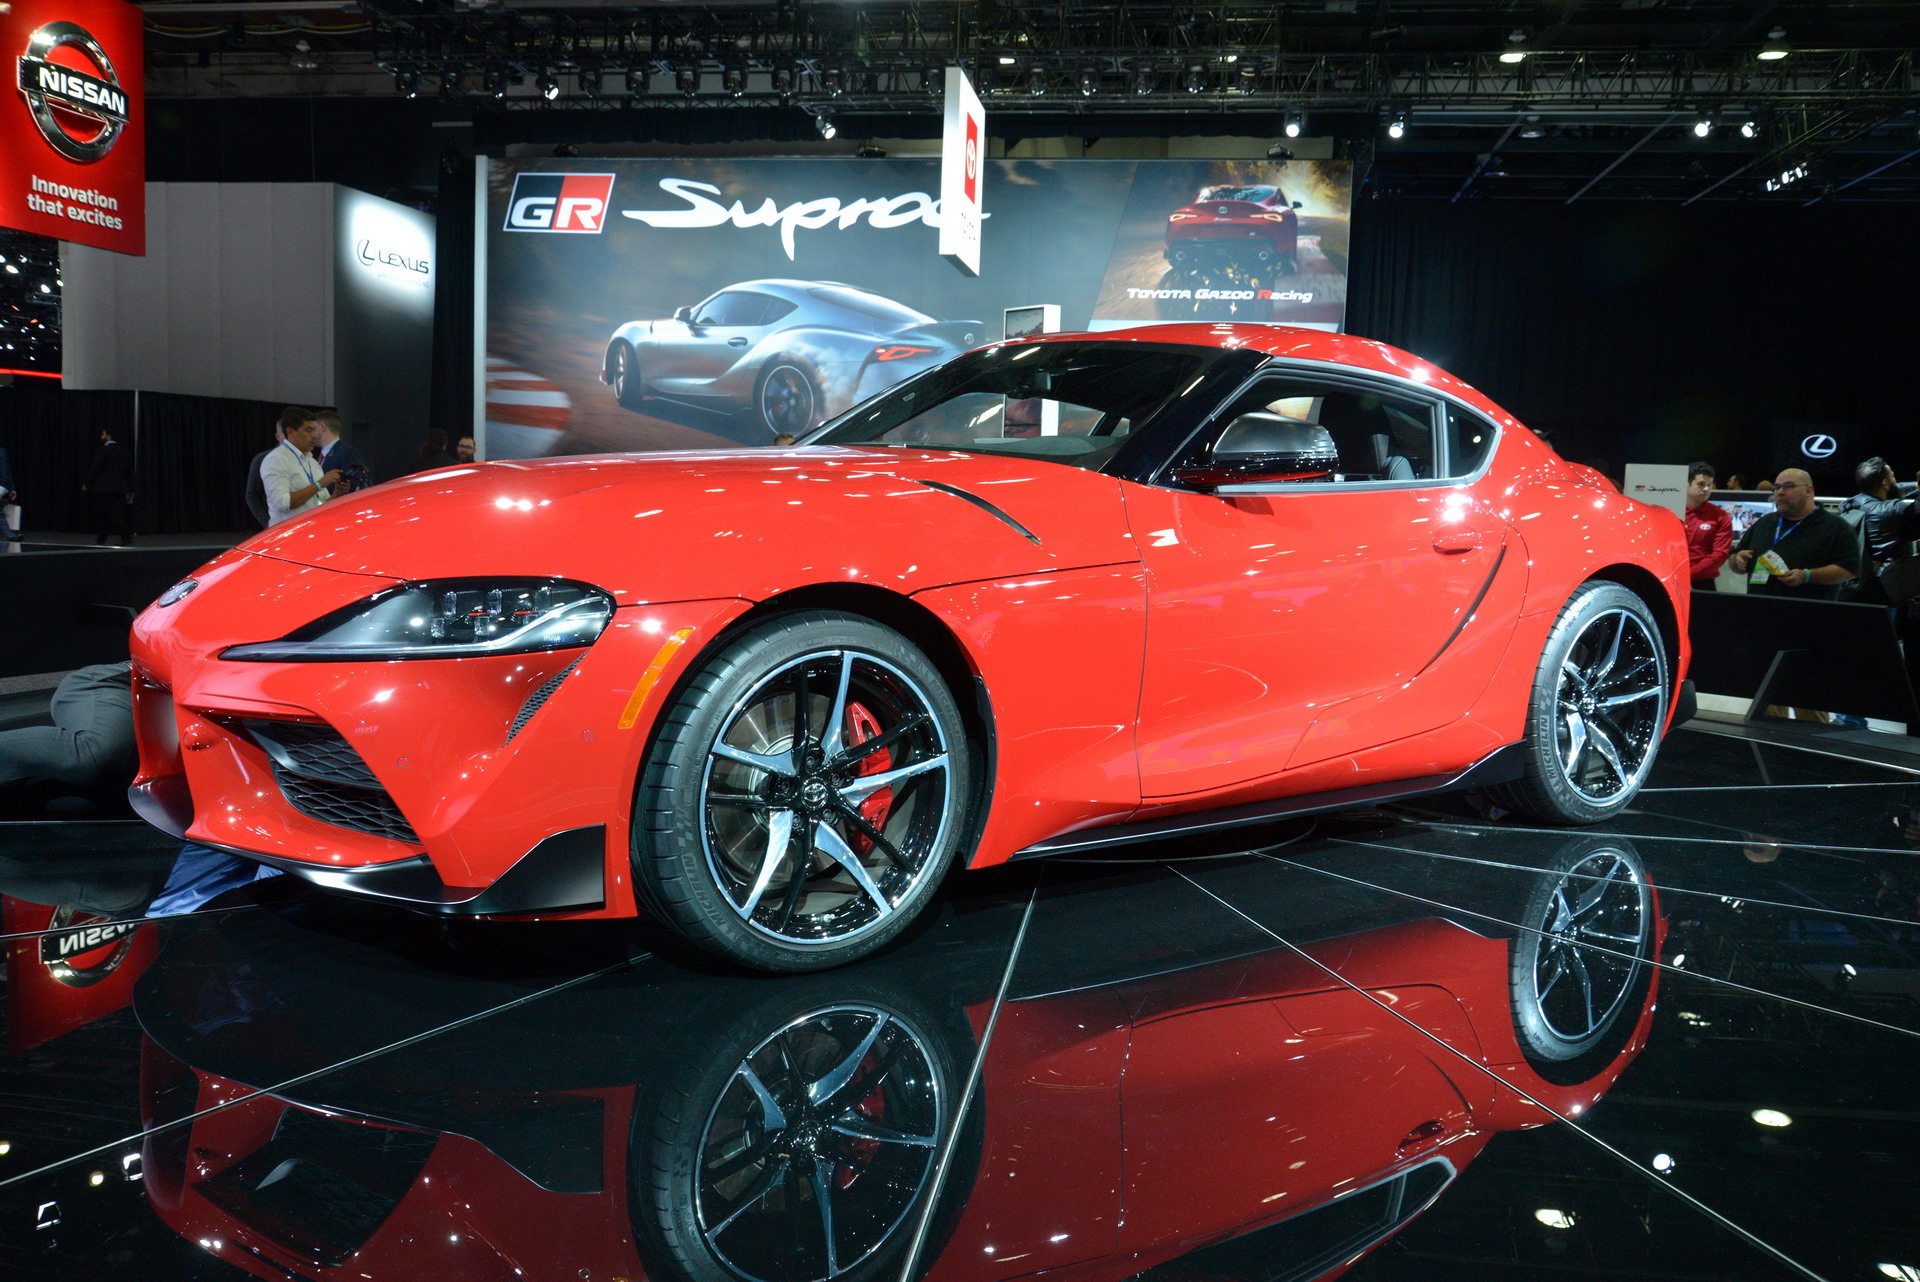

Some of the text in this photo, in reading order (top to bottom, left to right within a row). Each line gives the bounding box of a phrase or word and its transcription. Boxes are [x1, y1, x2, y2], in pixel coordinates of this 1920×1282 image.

[39, 67, 126, 115] NISSAN
[32, 174, 119, 211] Innovation
[27, 193, 124, 231] that excites
[510, 196, 604, 229] GR
[379, 250, 429, 274] LEXUS
[1126, 288, 1314, 304] TOYOTA GAZOO Racing
[1540, 716, 1557, 780] MICHELIN
[682, 853, 728, 927] MICHELIN
